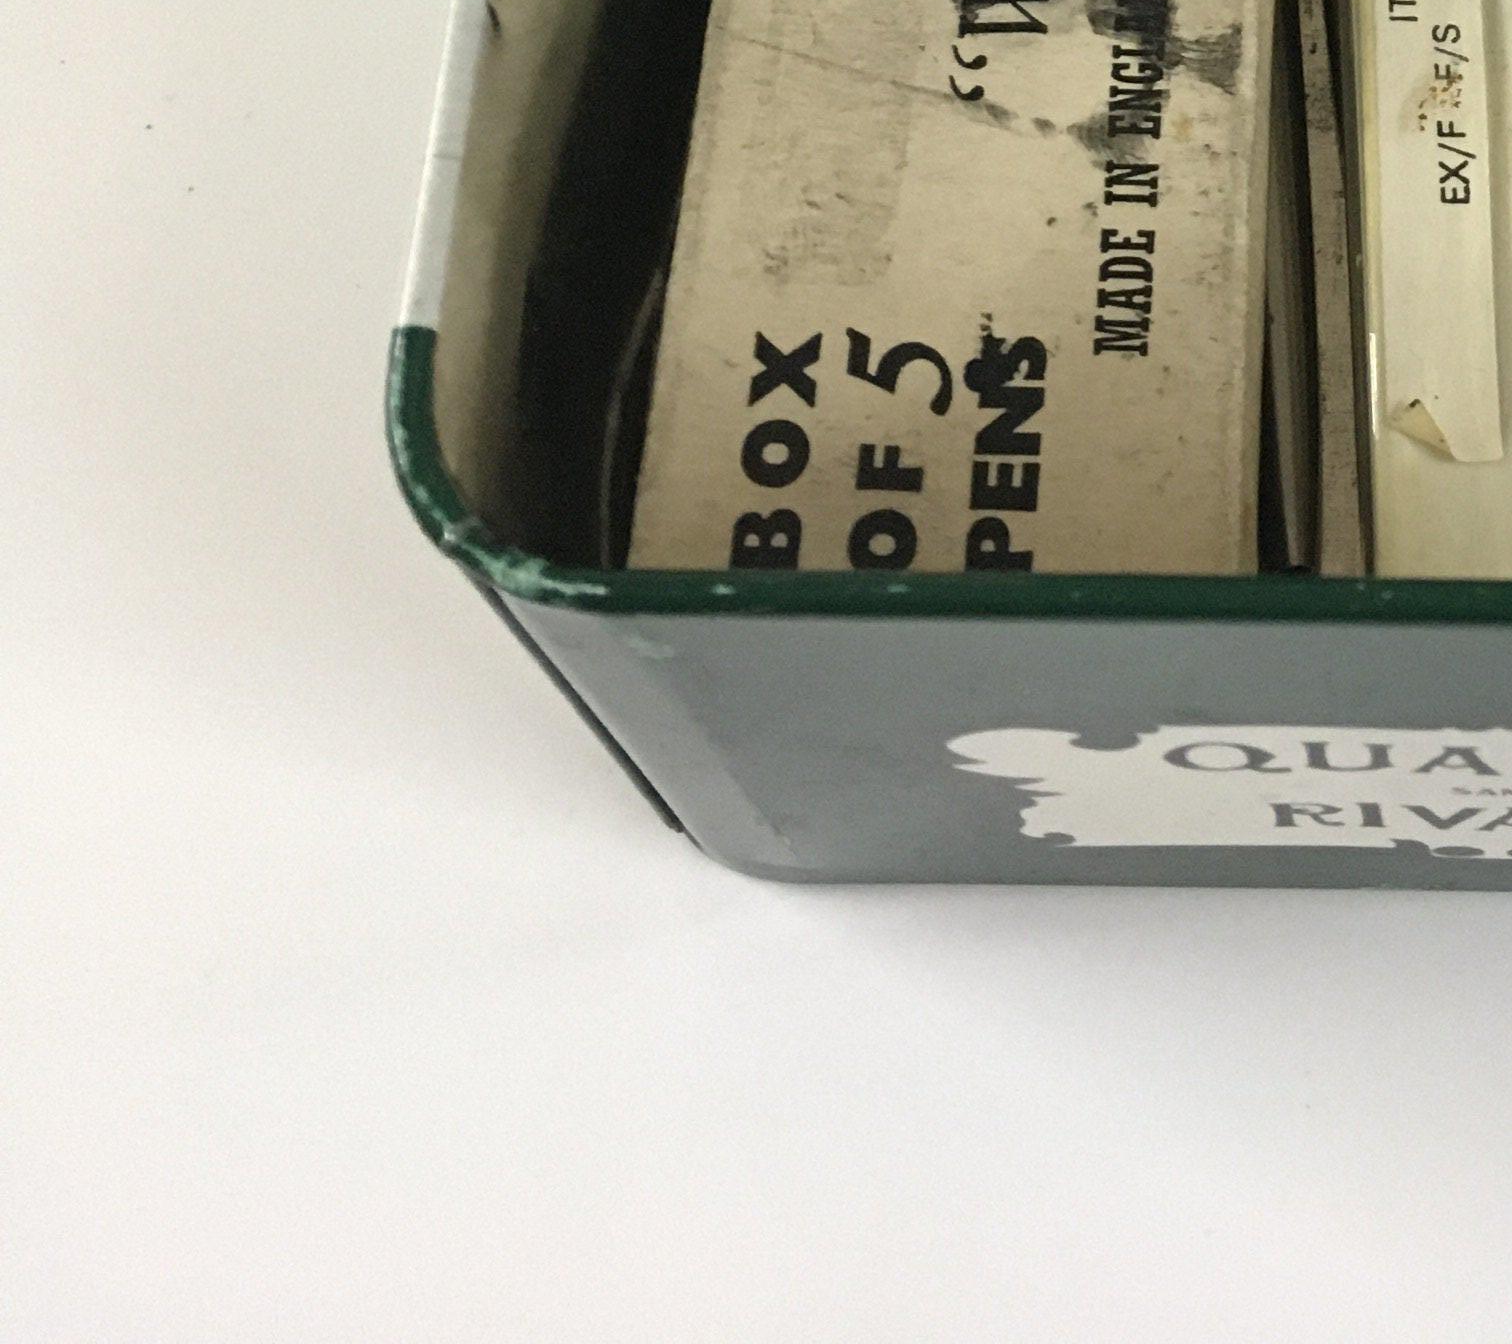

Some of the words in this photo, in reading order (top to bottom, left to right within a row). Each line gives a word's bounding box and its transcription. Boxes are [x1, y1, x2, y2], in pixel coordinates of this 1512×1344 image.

[1104, 159, 1160, 207] IN
[1435, 118, 1477, 206] EX/F
[1093, 228, 1157, 357] MADE
[846, 327, 954, 417] 5
[729, 330, 823, 570] BOX
[846, 442, 925, 570] OF
[964, 334, 1048, 571] PENS
